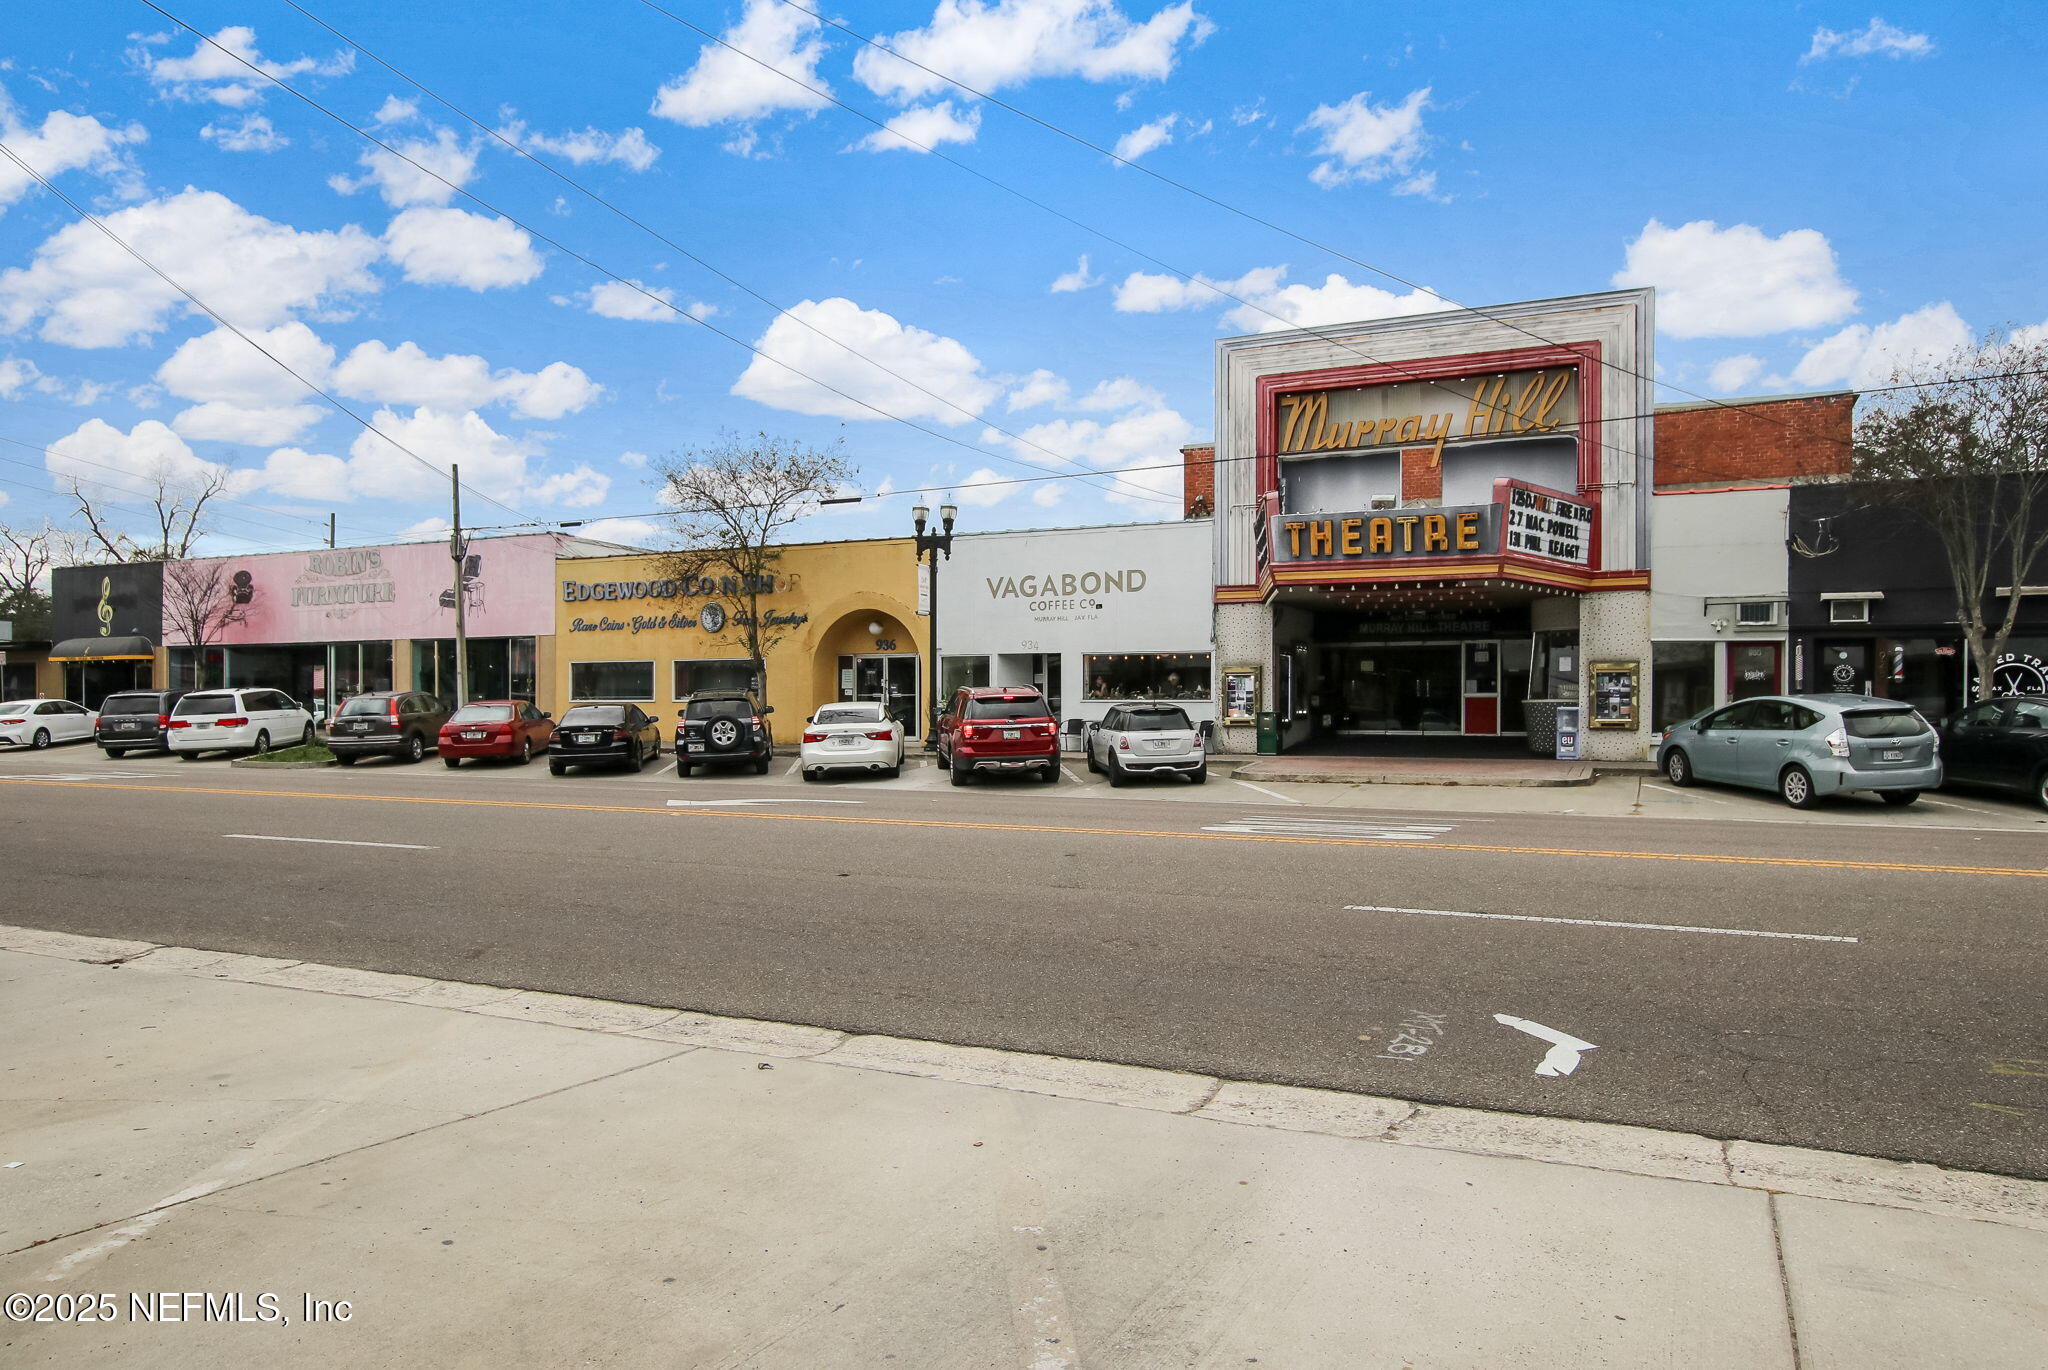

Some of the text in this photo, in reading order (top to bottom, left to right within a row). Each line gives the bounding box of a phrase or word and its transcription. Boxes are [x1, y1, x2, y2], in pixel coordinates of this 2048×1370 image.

[1281, 371, 1570, 468] Murray Hill
[1285, 512, 1480, 557] THEATRE
[1525, 514, 1545, 532] MAC
[1547, 518, 1579, 541] POWELL
[1525, 534, 1542, 552] PHIL
[308, 549, 382, 577] ROBIN'S
[291, 582, 396, 608] FURNITURE
[562, 579, 677, 602] EDGEWOOD
[986, 569, 1147, 599] VAGABOND
[1029, 600, 1075, 612] COFFEE
[599, 615, 625, 631] Coins
[631, 615, 656, 634] Gold
[657, 617, 667, 629] &
[669, 612, 697, 629] Silver
[1359, 623, 1404, 633] MURRAY
[1437, 620, 1491, 632] THEATRE
[875, 639, 897, 650] 936
[1021, 640, 1039, 650] 934
[1561, 736, 1573, 744] eu
